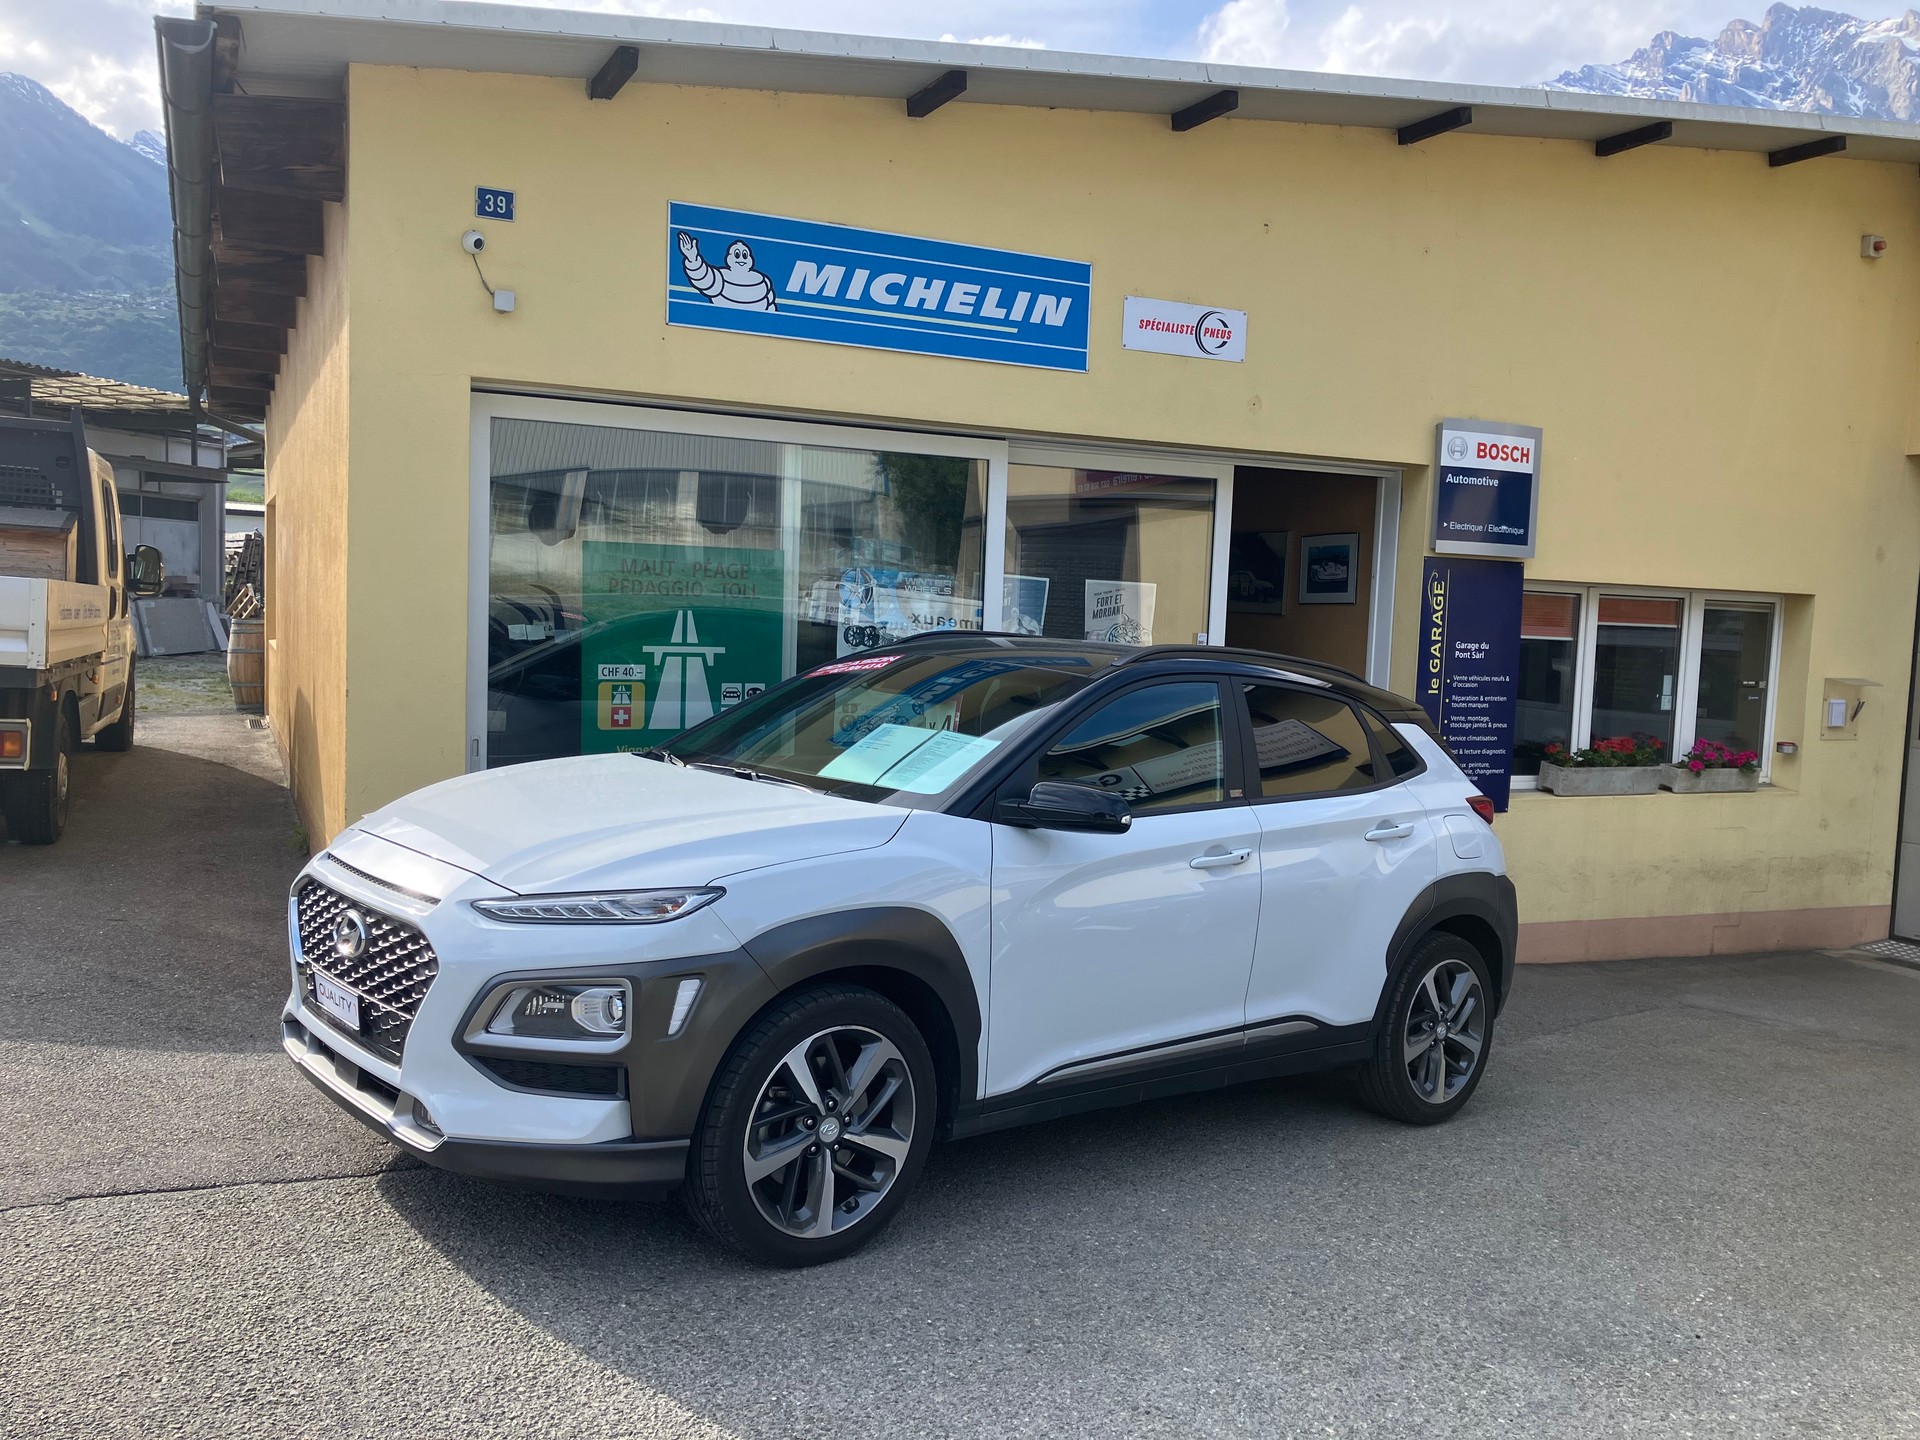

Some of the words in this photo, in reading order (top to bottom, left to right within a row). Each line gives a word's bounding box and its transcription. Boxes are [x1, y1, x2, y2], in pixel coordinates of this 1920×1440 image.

[484, 193, 507, 214] 39
[785, 260, 1073, 328] MICHELIN
[1138, 317, 1195, 336] SPÉCIALISTE
[1203, 326, 1233, 341] PNEUS
[1476, 442, 1531, 464] BOSCH
[1446, 473, 1499, 487] Automotive
[1450, 521, 1483, 532] Electrique
[620, 558, 676, 577] MAUT
[692, 557, 750, 580] PÉAGE
[905, 576, 951, 586] WINTER
[904, 585, 952, 595] WHEELS
[1096, 596, 1113, 608] FORT
[1114, 593, 1123, 605] ET
[1092, 604, 1125, 620] MORDANT
[1429, 580, 1446, 673] GARAGE
[1455, 641, 1480, 651] Garage
[1480, 642, 1490, 650] du
[1455, 651, 1471, 659] Pont
[1471, 651, 1485, 659] Sàrl
[601, 666, 620, 677] CHF
[1428, 678, 1440, 694] le
